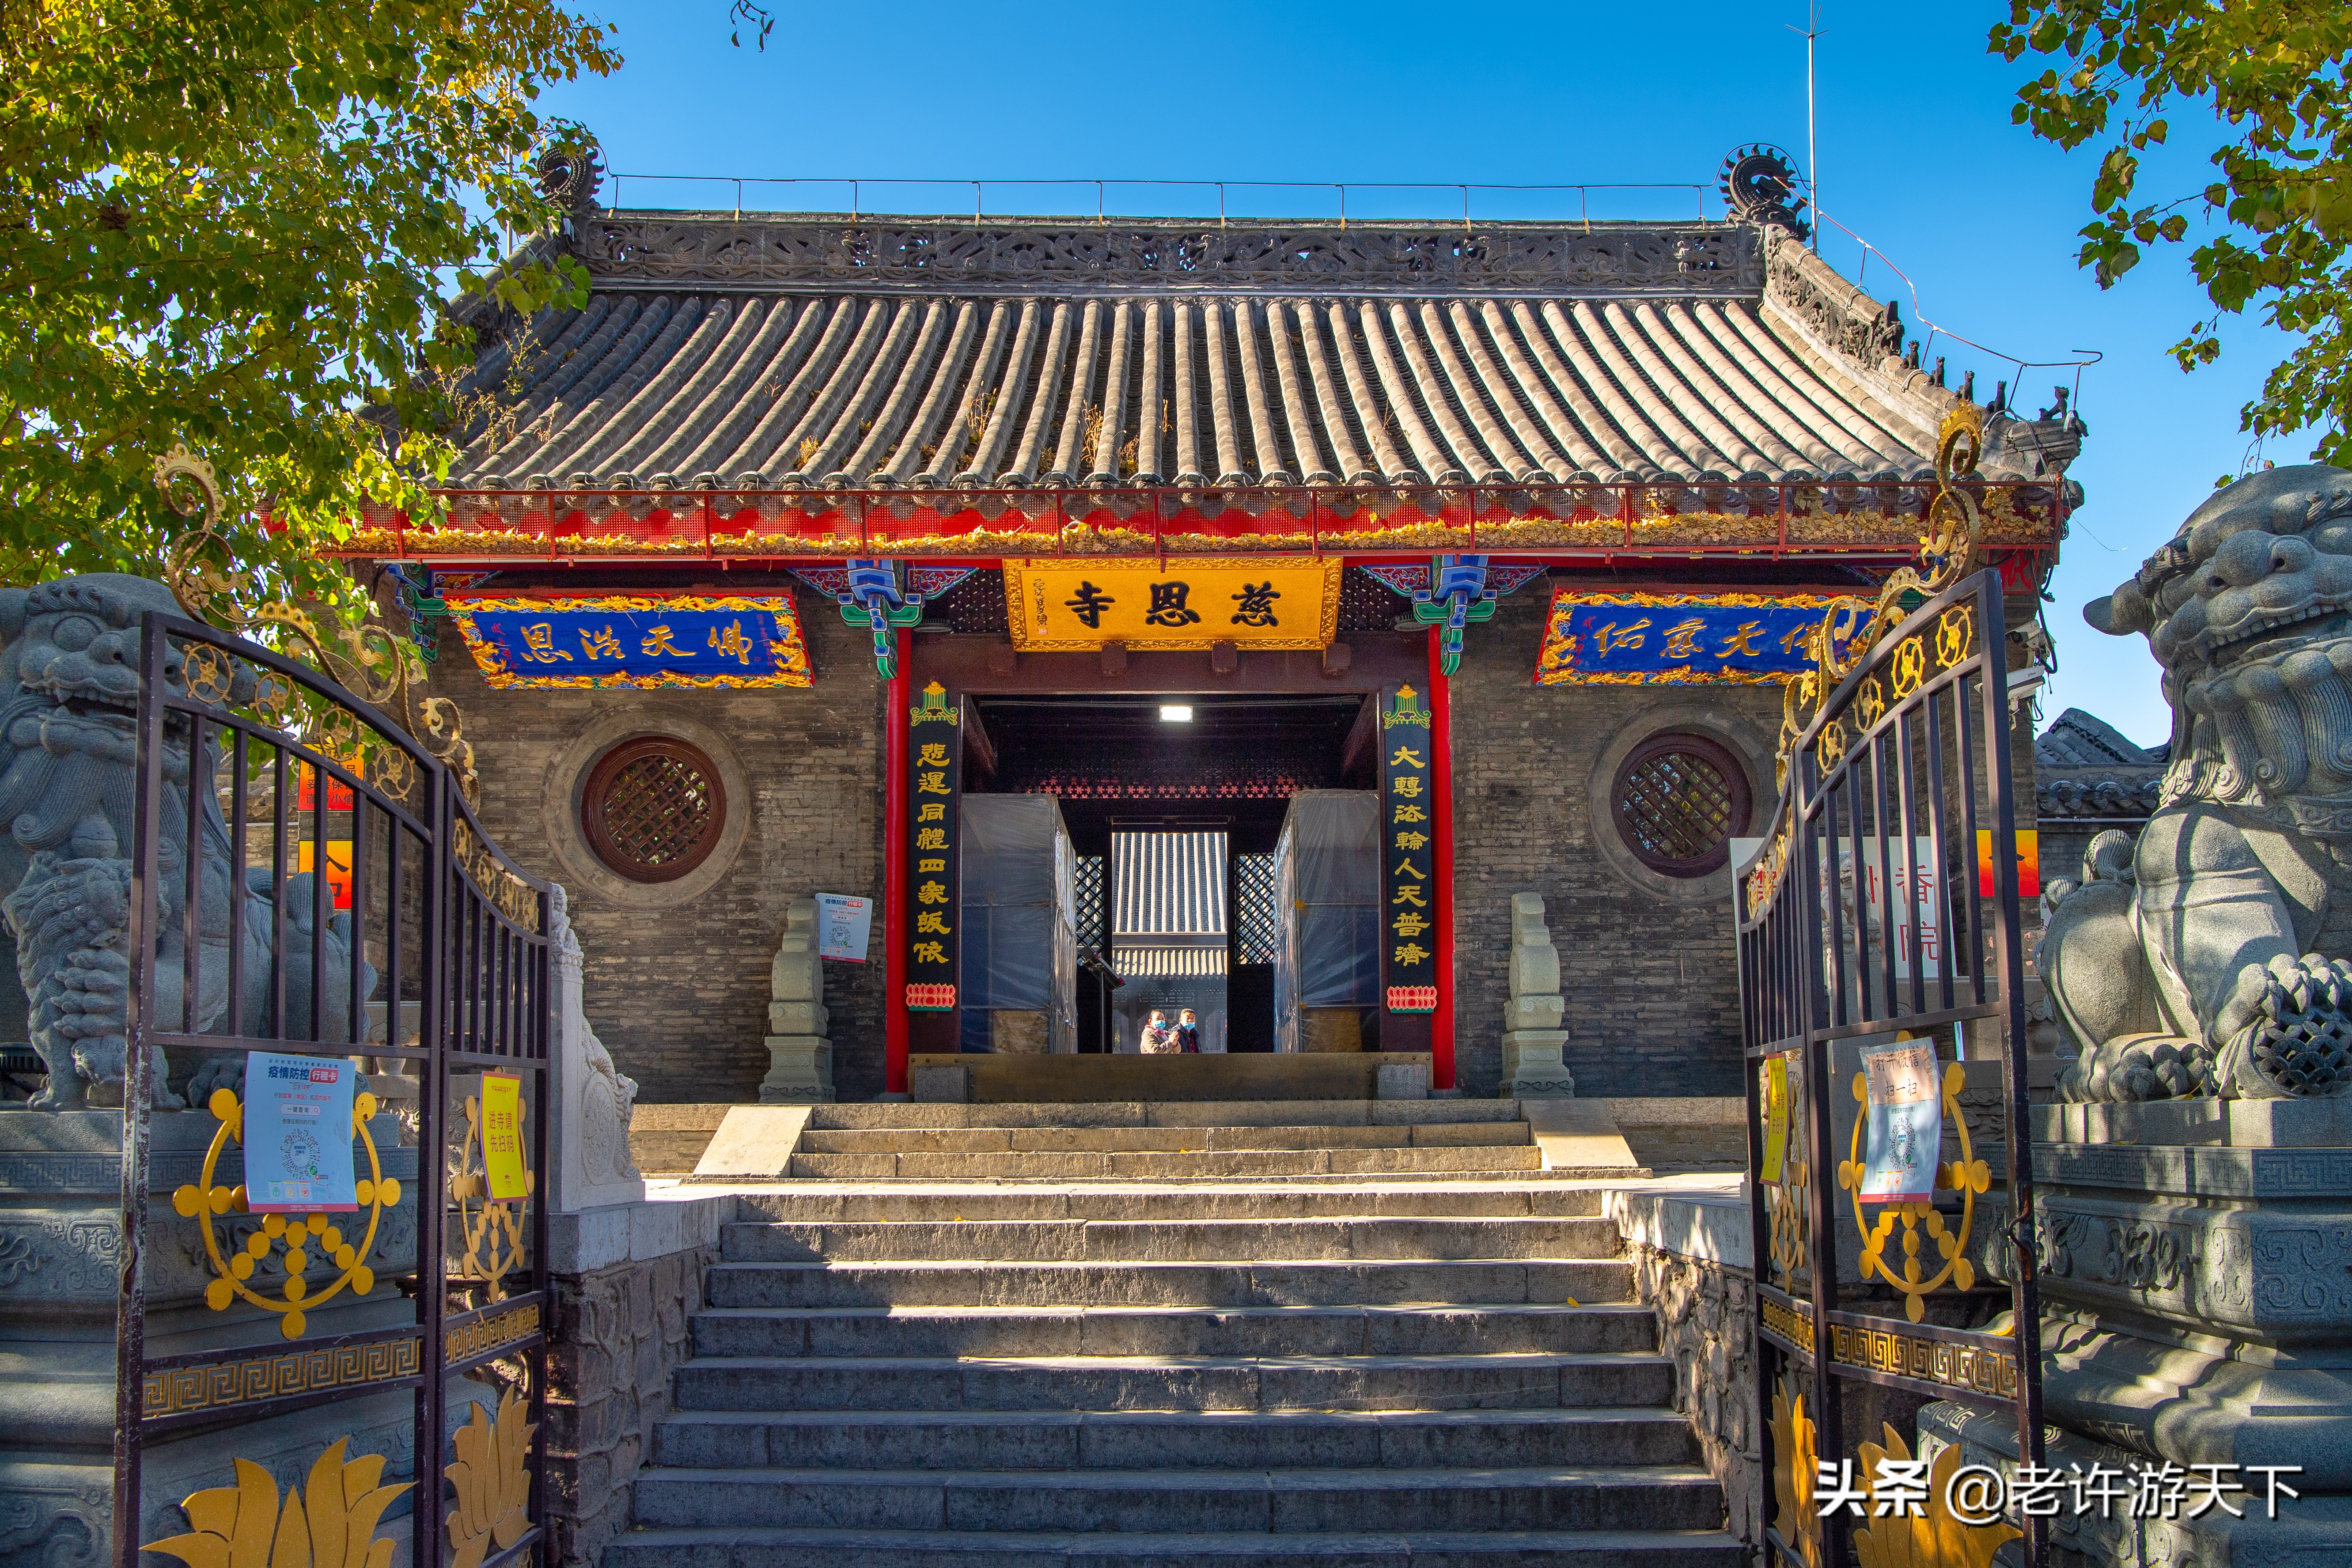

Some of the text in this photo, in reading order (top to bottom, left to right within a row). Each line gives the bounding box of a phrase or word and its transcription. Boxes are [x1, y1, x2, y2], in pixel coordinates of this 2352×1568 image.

[1064, 580, 1281, 630] 慈恩寺
[1876, 1049, 1919, 1072] 打开微信
[268, 1065, 337, 1081] 疫情防控 行程卡
[1884, 1078, 1917, 1098] 扫一扫
[489, 1111, 512, 1130] 进寺请
[490, 1133, 514, 1152] 先扫码
